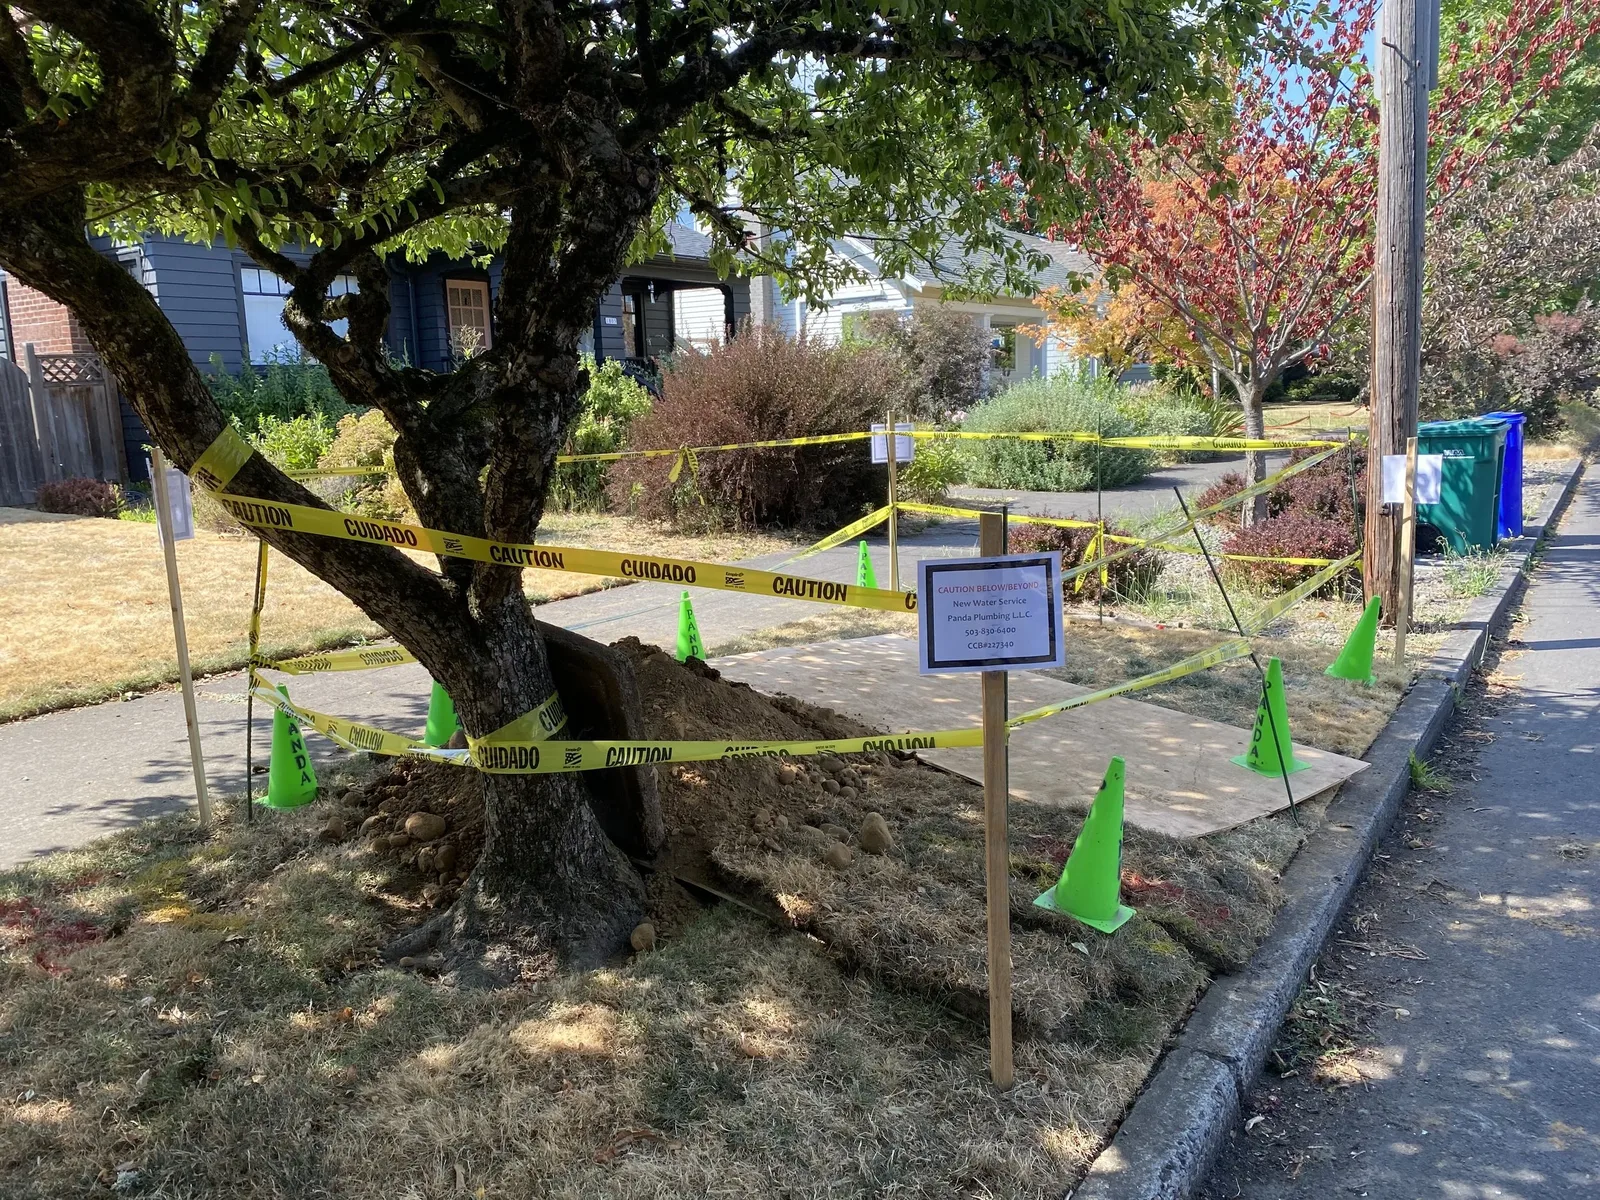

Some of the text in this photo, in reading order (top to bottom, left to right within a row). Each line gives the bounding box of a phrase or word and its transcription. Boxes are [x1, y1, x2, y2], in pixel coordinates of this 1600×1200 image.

[221, 499, 848, 602] CAUTION CUIDADO CAUTION CUIDADO CAUTION
[860, 552, 868, 587] PAND
[938, 581, 1039, 594] CAUTION BELOW/BEYOND
[973, 599, 997, 607] Water
[998, 597, 1027, 606] Service
[947, 611, 1033, 622] Panda Plumbing L.L.C.
[686, 608, 699, 656] PAND
[965, 627, 1016, 637] 503-830-6400
[967, 641, 1014, 650] CCB#227340
[286, 714, 311, 786] ANDA
[478, 745, 672, 770] CUIDADO CAUTION
